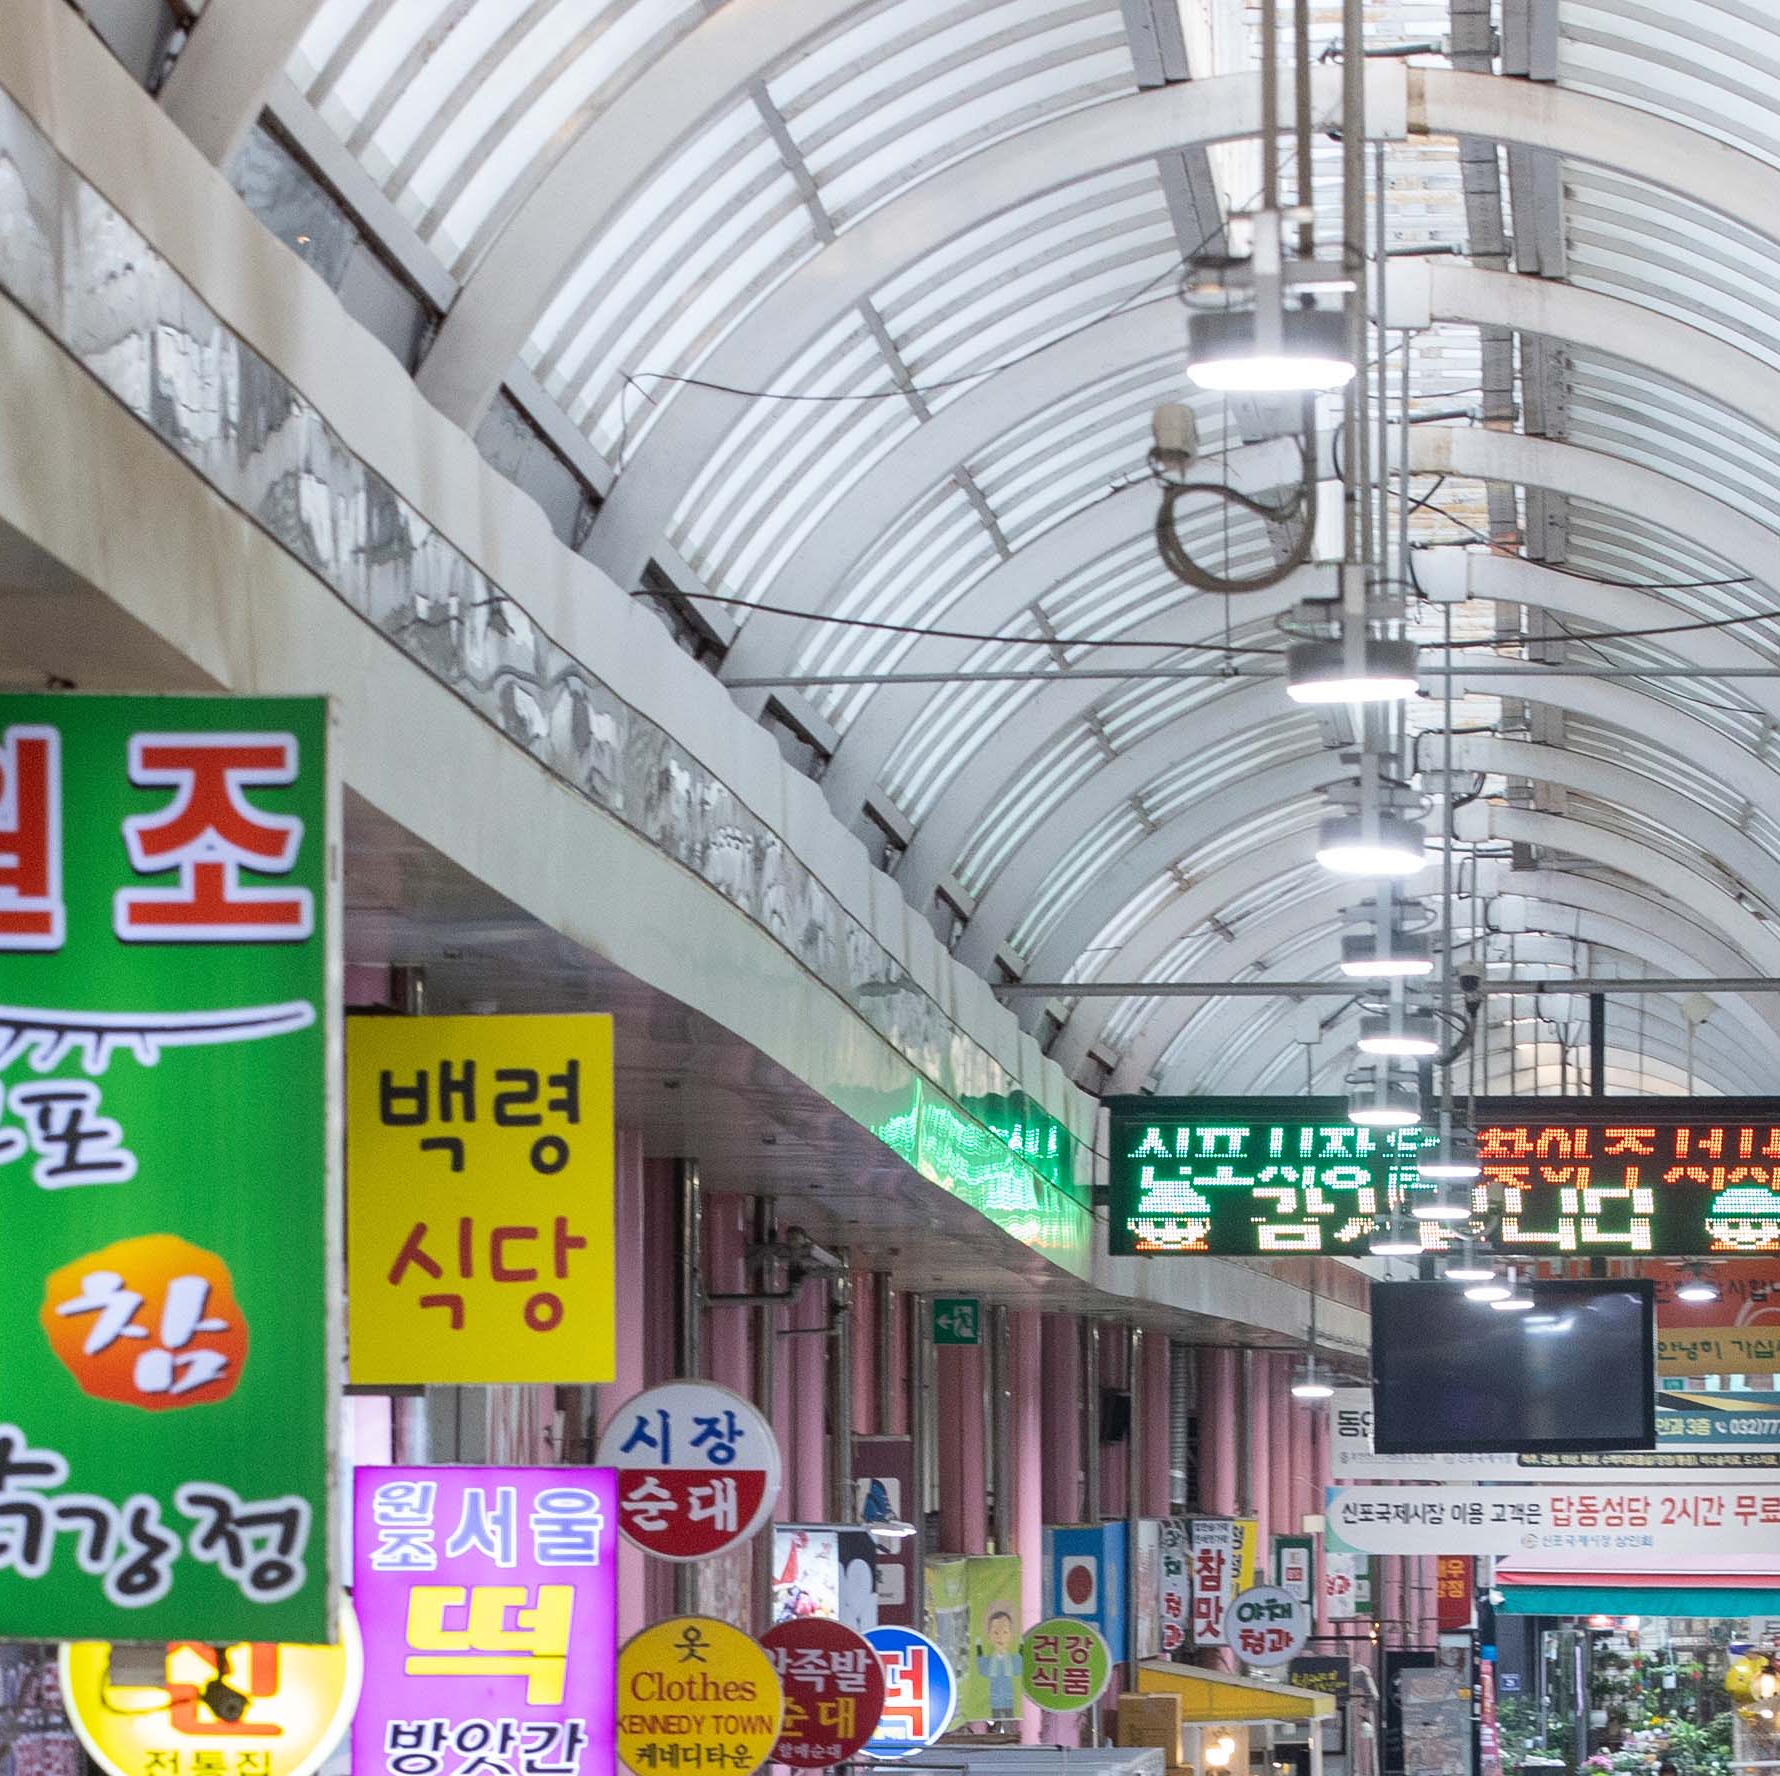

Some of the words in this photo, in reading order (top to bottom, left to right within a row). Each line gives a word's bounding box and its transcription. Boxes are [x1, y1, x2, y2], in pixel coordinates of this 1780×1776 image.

[378, 1057, 582, 1175] 백령
[388, 1216, 587, 1334] 식당
[54, 1268, 232, 1400] 참
[620, 1409, 744, 1466] 시장
[446, 1485, 605, 1568] 서울
[620, 1477, 739, 1533] 순대
[1341, 1502, 1446, 1525] 신포국제시장
[1450, 1502, 1485, 1525] 이용
[1490, 1502, 1543, 1525] 고객은
[1550, 1494, 1651, 1528] 답동성당
[1660, 1494, 1725, 1528] 2시간
[1193, 1548, 1226, 1640] 참맛
[404, 1582, 578, 1707] 떡
[1030, 1634, 1094, 1666] 건강
[1238, 1627, 1295, 1656] 청과
[630, 1671, 758, 1704] Clothes
[1030, 1669, 1092, 1697] 식품
[617, 1714, 705, 1736] KENNEDY
[713, 1714, 773, 1736] TOWN
[635, 1744, 754, 1770] 케네디타운
